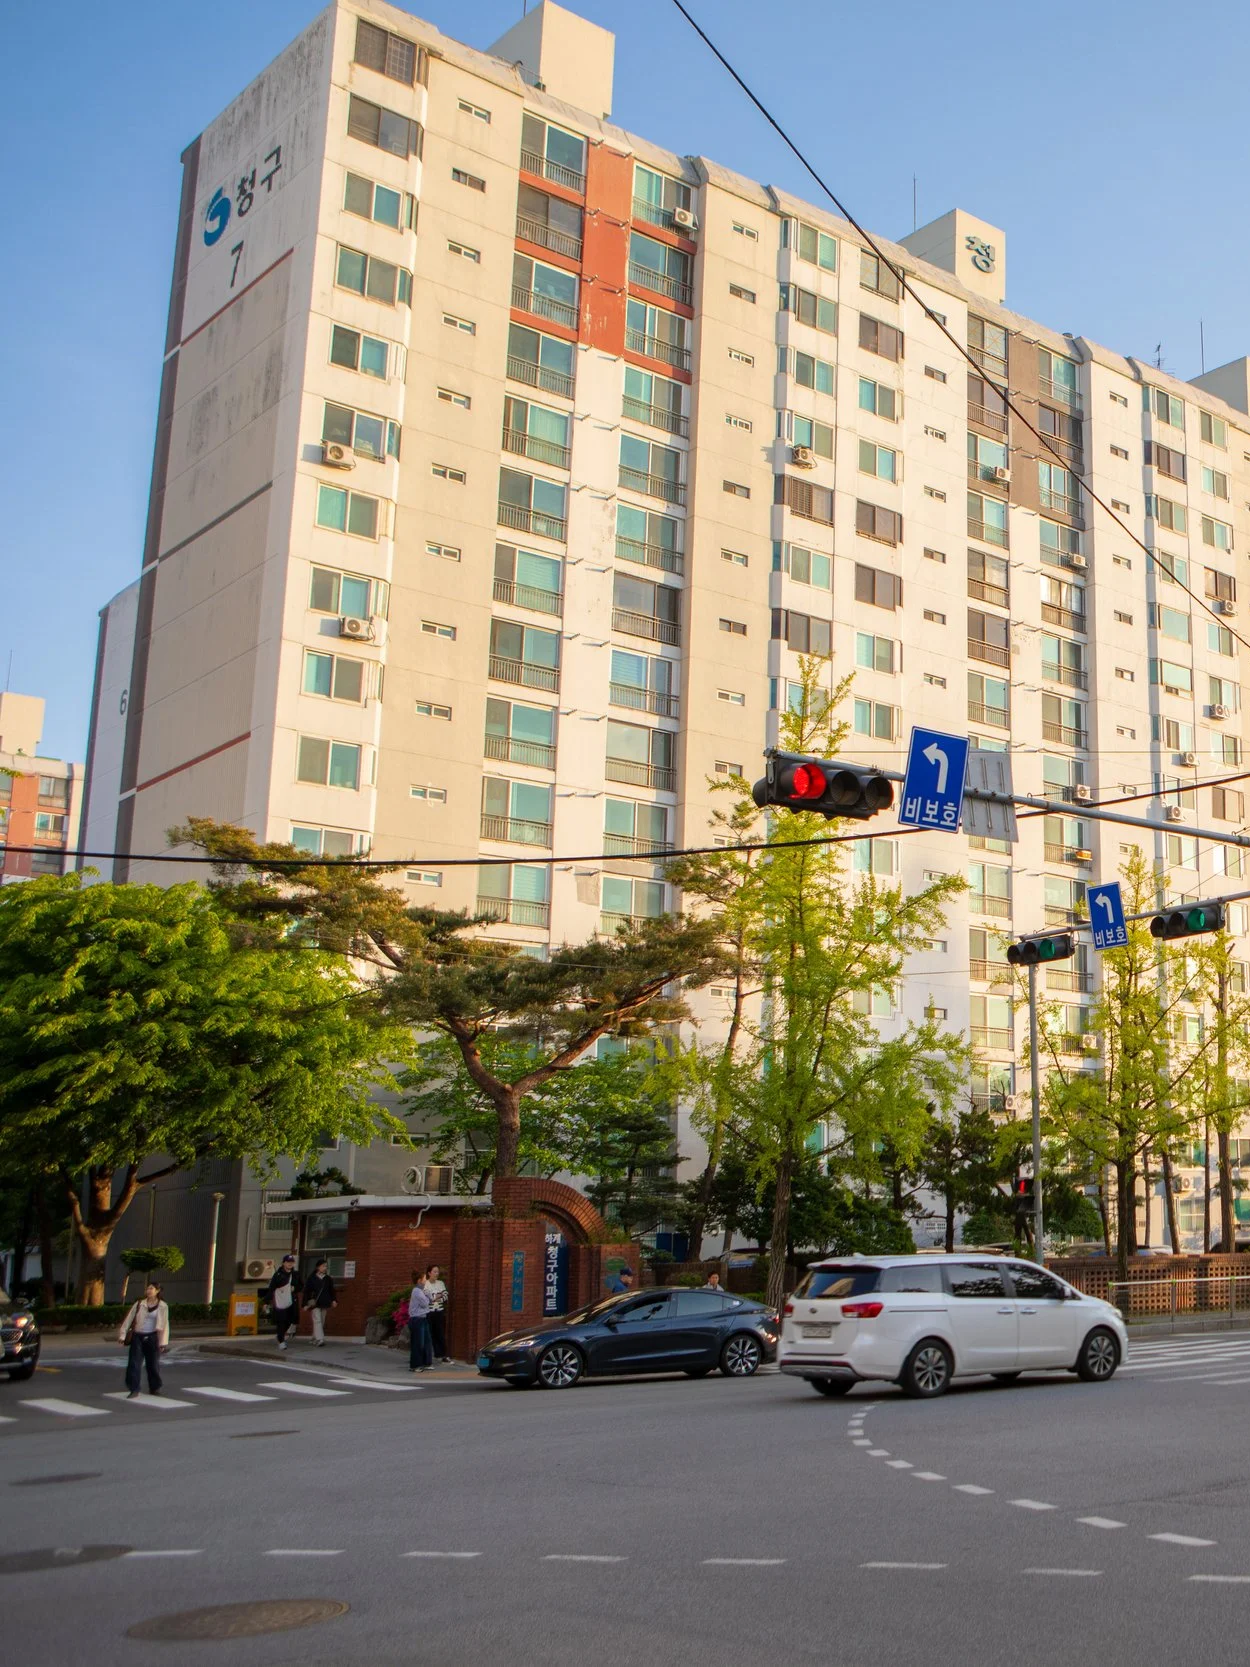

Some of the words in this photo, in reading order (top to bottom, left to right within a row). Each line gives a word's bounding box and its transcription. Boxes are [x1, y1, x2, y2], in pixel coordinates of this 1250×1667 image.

[236, 145, 282, 218] 청구
[230, 239, 245, 289] 7
[965, 236, 996, 274] 청
[119, 689, 129, 716] 6
[904, 795, 957, 828] 비보호
[1094, 926, 1127, 948] 비보호
[544, 1233, 561, 1245] 하계
[545, 1246, 559, 1311] 청구아파트
